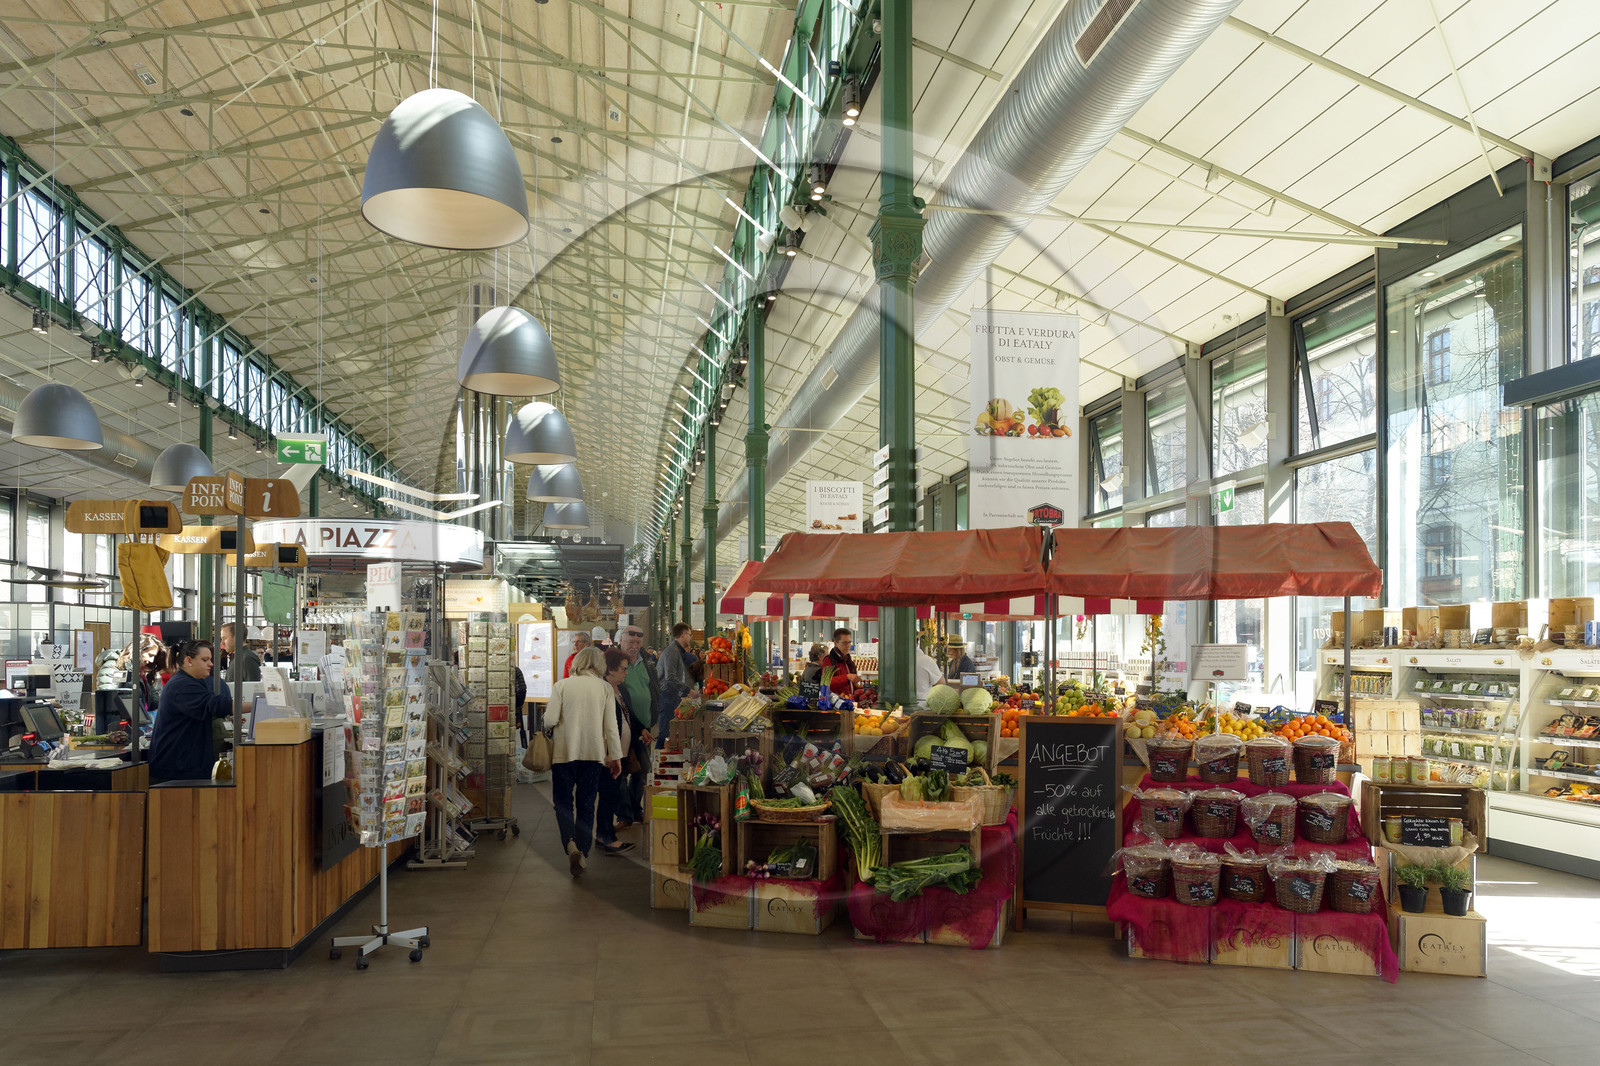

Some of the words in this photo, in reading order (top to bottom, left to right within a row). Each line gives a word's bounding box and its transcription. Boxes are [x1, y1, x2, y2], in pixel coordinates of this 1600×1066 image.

[975, 324, 1016, 335] FRUTTA
[1026, 328, 1076, 338] VERDURA
[998, 338, 1010, 347] DI
[1014, 339, 1053, 349] EATALY
[1024, 356, 1056, 365] GEMÜSE
[229, 478, 243, 495] INFO
[229, 490, 243, 507] POINT
[84, 512, 124, 521] KASSEN
[173, 536, 207, 544] KASSEN
[320, 528, 417, 550] PIAZZA
[1030, 742, 1110, 766] ANGEBOT
[1082, 784, 1103, 798] auf
[1036, 803, 1055, 817] alle
[1032, 826, 1074, 841] Früchte
[1317, 943, 1358, 952] EATALY
[1422, 943, 1465, 952] EATALY
